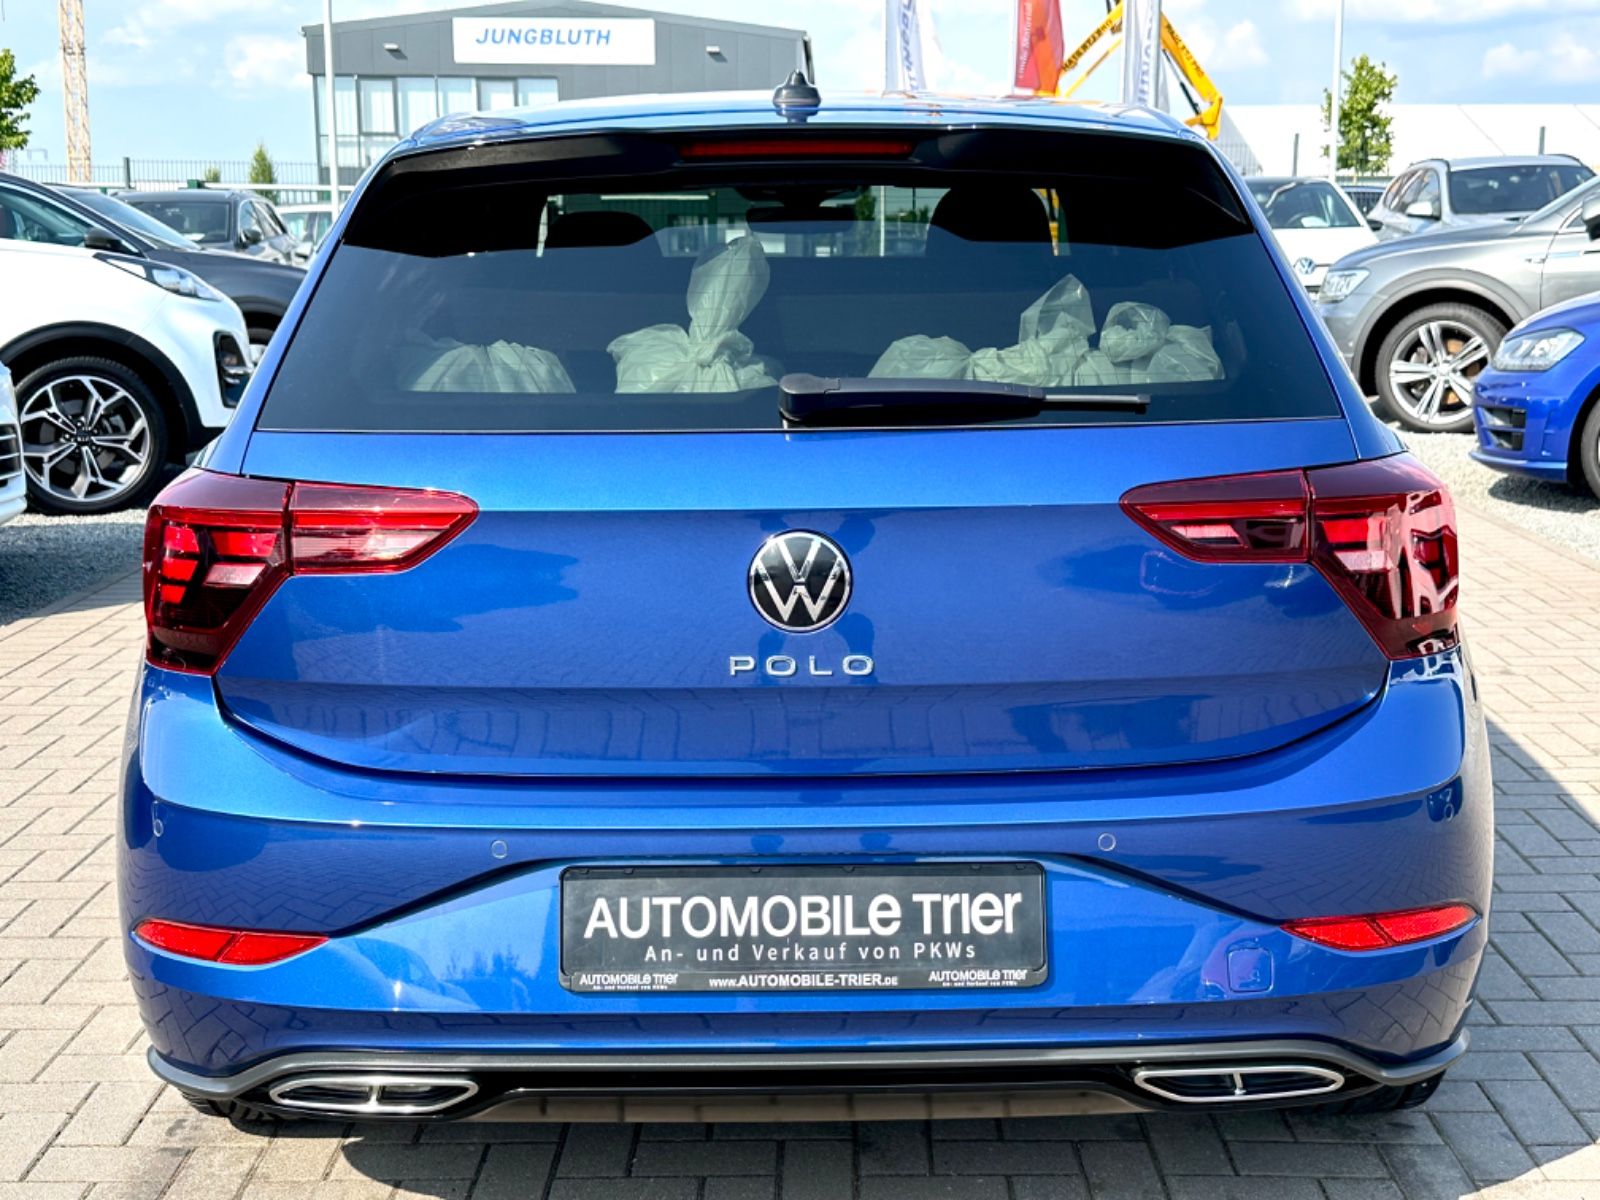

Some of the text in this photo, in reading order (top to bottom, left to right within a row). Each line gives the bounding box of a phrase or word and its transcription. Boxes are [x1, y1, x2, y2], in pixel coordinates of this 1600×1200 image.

[476, 27, 611, 46] JUNGBLUTH
[729, 655, 874, 676] POLO
[644, 941, 976, 962] An- und Verkauf von PKWs
